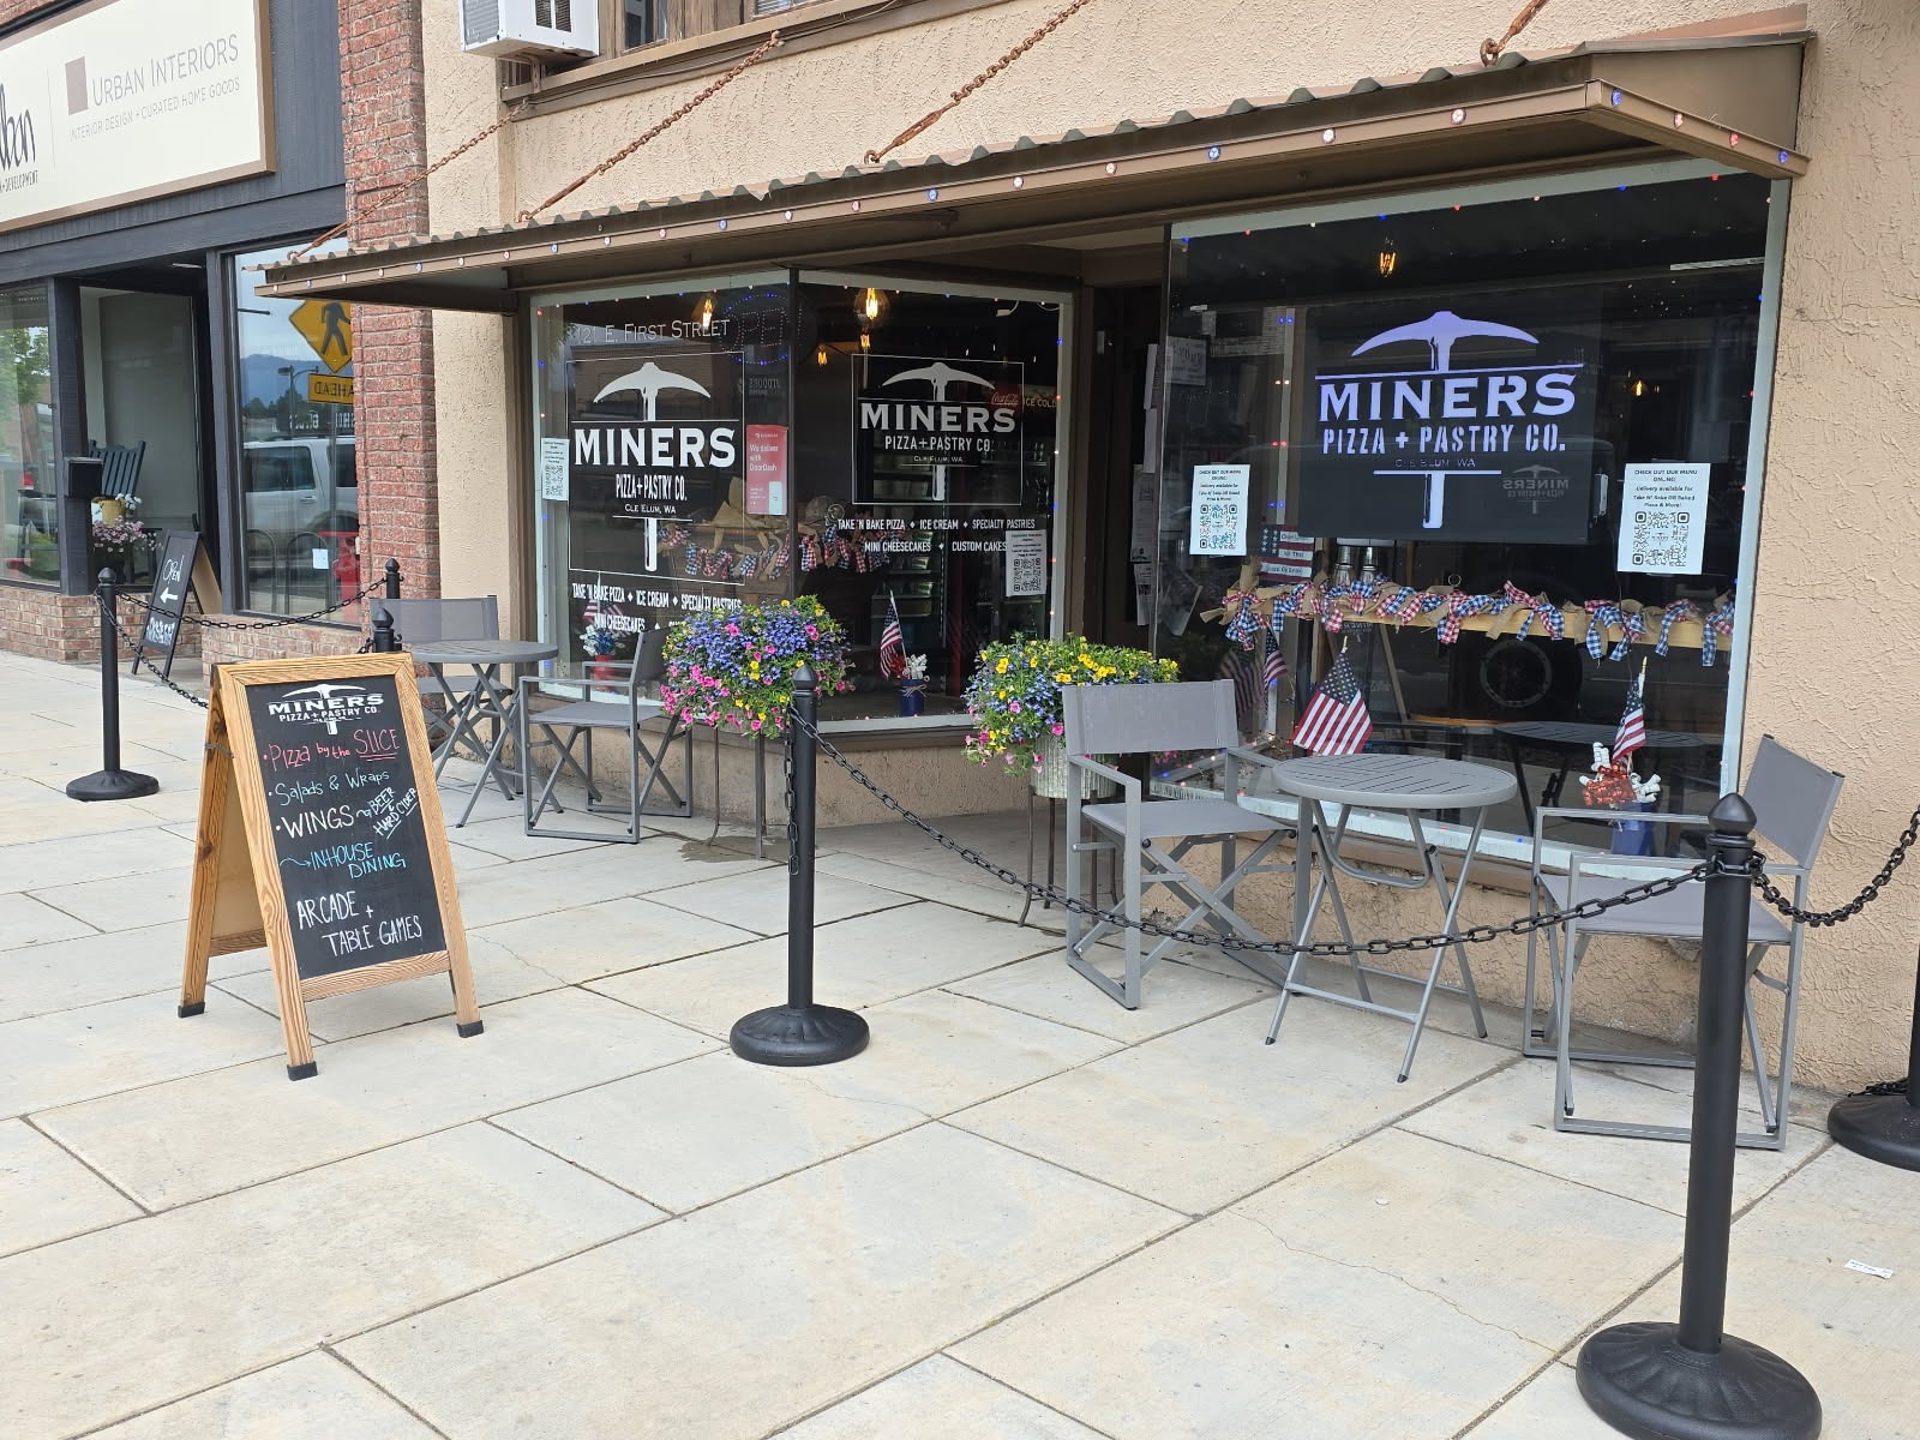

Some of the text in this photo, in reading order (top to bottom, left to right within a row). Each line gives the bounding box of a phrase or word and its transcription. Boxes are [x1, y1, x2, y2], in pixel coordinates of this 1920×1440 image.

[92, 33, 239, 107] URBAN INTERIORS
[105, 110, 133, 131] DESIGN
[141, 96, 179, 119] CURATED
[182, 87, 206, 107] HOME
[209, 77, 240, 98] GOODS
[624, 323, 667, 342] FIRST
[671, 319, 730, 338] STREET
[1319, 373, 1577, 421] MINERS
[860, 402, 1016, 433] MINERS
[573, 426, 736, 468] MINERS
[1322, 427, 1386, 454] PIZZA
[1419, 424, 1514, 454] PASTRY
[1525, 423, 1566, 452] CO.
[1457, 458, 1476, 467] WA
[674, 475, 688, 501] CO.
[624, 503, 639, 512] CLE
[664, 505, 677, 514] WA
[838, 519, 855, 530] TAKE
[865, 519, 885, 530] BAKE
[886, 519, 905, 530] PIZZA
[919, 519, 932, 529] ICE
[932, 519, 959, 529] CREAM
[971, 518, 1004, 529] SPECIALTY
[1006, 518, 1036, 529] PASTRIES
[864, 541, 880, 552] MINI
[882, 541, 931, 552] CHEESECAKES
[952, 541, 982, 552] CUSTOM
[984, 541, 1008, 552] CAKES
[609, 586, 625, 603] PIZZA
[636, 590, 646, 606] ICE
[647, 591, 669, 608] CREAM
[268, 693, 385, 715] MINERS
[279, 713, 310, 722] PIZZA
[321, 707, 360, 718] PASTRY
[315, 743, 330, 757] by
[332, 745, 351, 759] the
[275, 781, 324, 806] Salads
[329, 774, 340, 790] &
[367, 786, 396, 816] BEER
[281, 804, 355, 838] WINGS
[372, 787, 418, 837] HARD CIDER
[310, 841, 374, 871] INHOUSE
[348, 853, 407, 879] DINING
[296, 890, 374, 930] ARCADE +
[321, 915, 423, 957] TABLE GAMES
